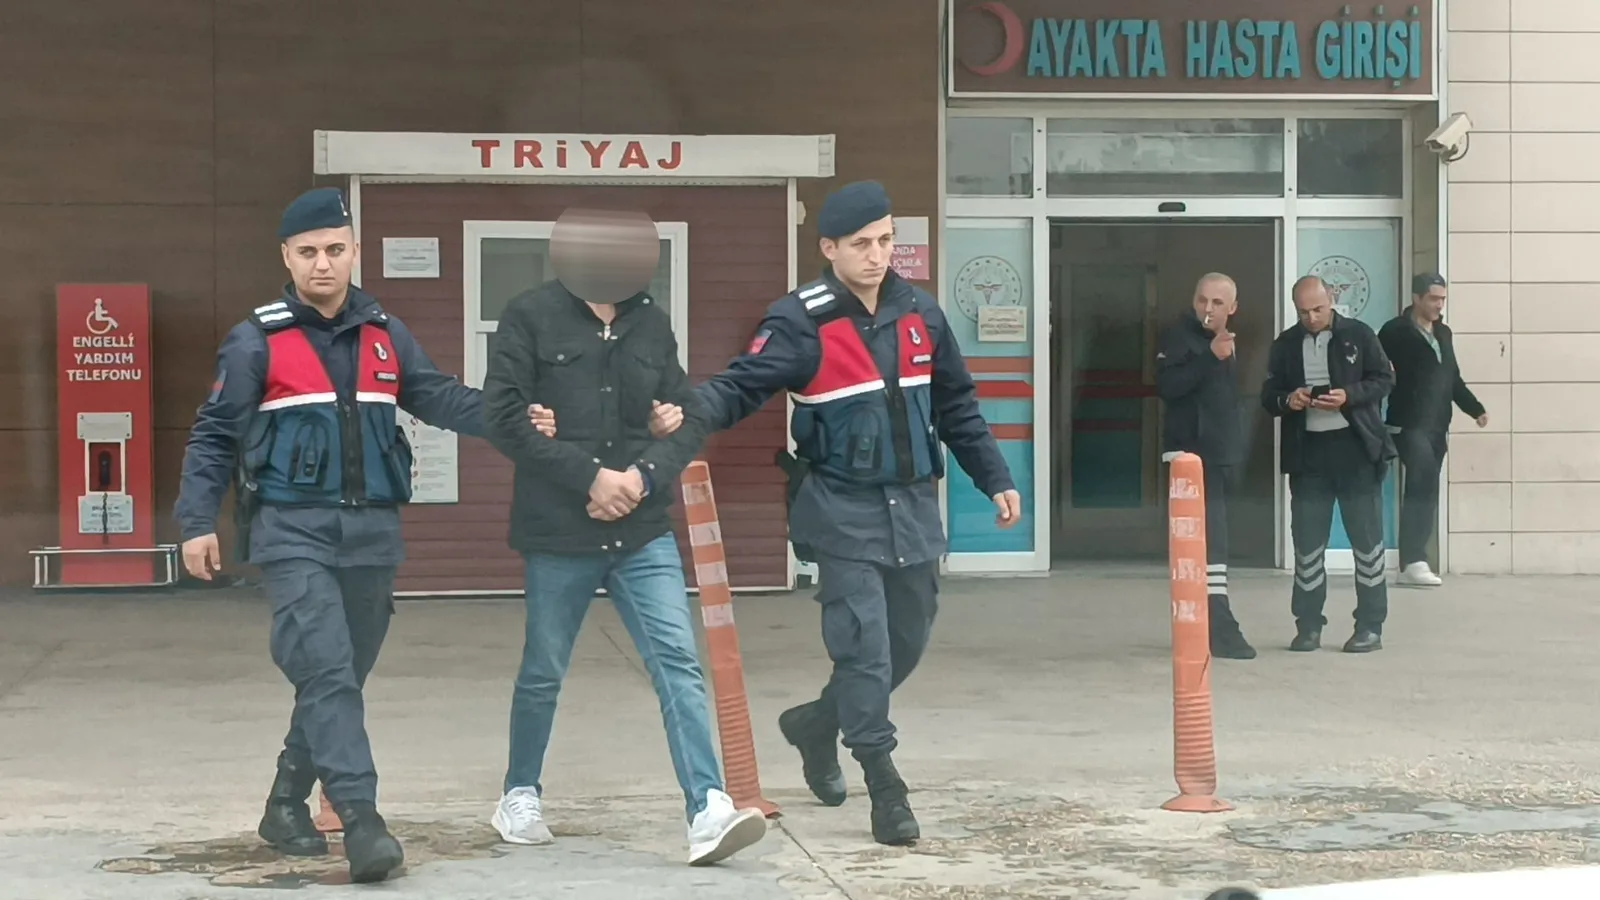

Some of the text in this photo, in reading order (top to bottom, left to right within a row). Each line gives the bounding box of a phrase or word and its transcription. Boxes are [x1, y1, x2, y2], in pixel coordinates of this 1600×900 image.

[1026, 4, 1421, 90] AYAKTA HASTA GİRİŞİ
[72, 333, 135, 348] ENGELLİ
[74, 352, 134, 365] YARDIM
[66, 368, 142, 382] TELEFONU
